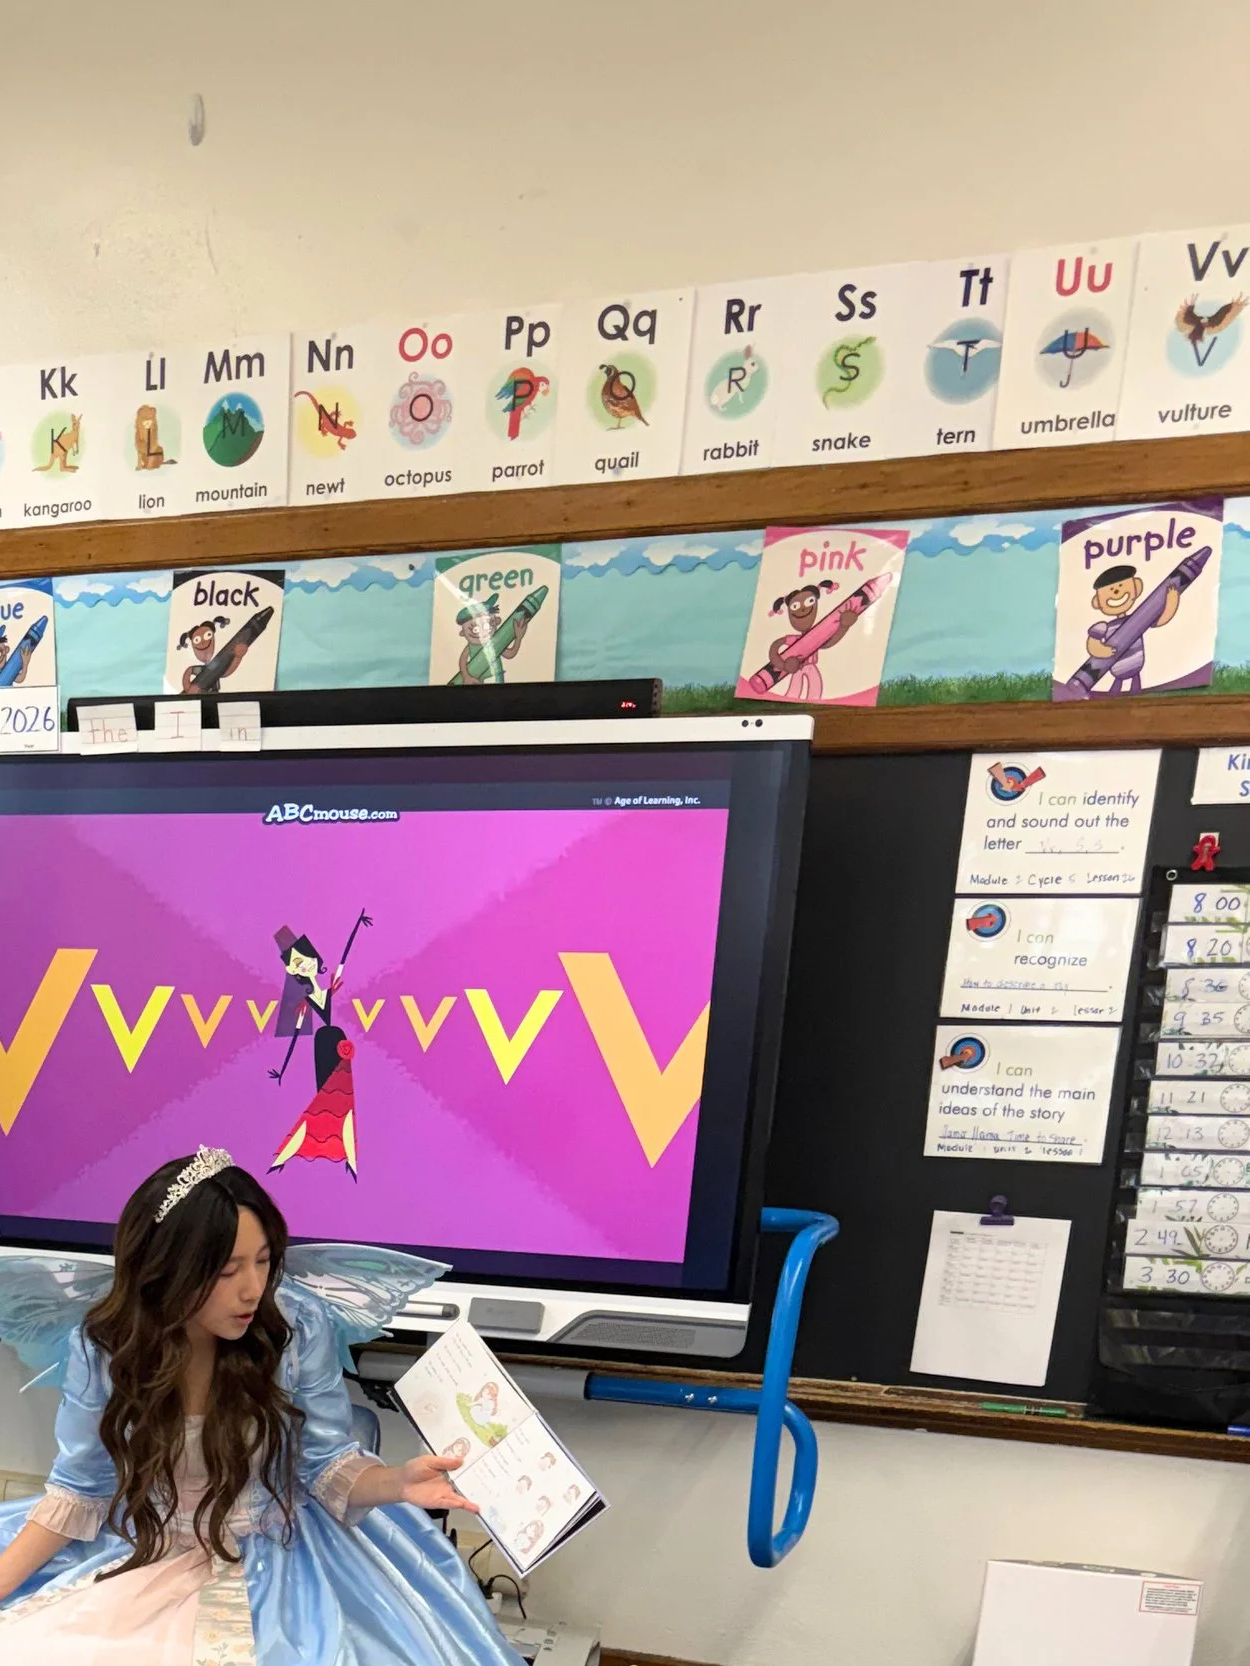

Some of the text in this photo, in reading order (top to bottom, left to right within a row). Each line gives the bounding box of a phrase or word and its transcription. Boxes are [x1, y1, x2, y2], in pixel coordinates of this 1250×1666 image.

[1187, 241, 1250, 282] Vv
[958, 267, 993, 307] Tt
[1055, 256, 1113, 296] Uu
[835, 284, 877, 321] Ss
[598, 304, 657, 345] Qq
[724, 299, 761, 334] Rr
[399, 327, 453, 362] Oo
[505, 316, 550, 357] Pp
[203, 349, 265, 384] Mm
[308, 339, 354, 373] Nn
[40, 366, 78, 400] Kk
[145, 358, 165, 391] Ll
[1020, 410, 1116, 435] umbrella
[1158, 401, 1232, 425] vulture
[812, 432, 871, 452] snake
[936, 427, 976, 446] tern
[703, 439, 759, 462] rabbit
[492, 459, 545, 481] parrot
[594, 452, 639, 474] quail
[305, 477, 345, 496] newt
[384, 469, 452, 488] octopus
[138, 494, 165, 509] lion
[195, 482, 268, 503] mountain
[24, 498, 92, 519] kangaroo
[1084, 518, 1198, 570] purple
[799, 541, 866, 577] pink
[459, 566, 534, 599] green
[194, 581, 260, 609] black
[89, 716, 129, 744] the
[170, 711, 186, 739] I
[228, 723, 249, 742] in
[615, 796, 700, 807] Age Learning, Inc.
[1049, 790, 1140, 809] can identify
[264, 803, 398, 823] ABCmouse.com
[987, 813, 1128, 828] and sound out the
[984, 837, 1022, 850] letter
[1027, 933, 1053, 943] can
[1014, 954, 1087, 968] recognize
[91, 985, 175, 1073] V
[181, 995, 233, 1048] V
[247, 1001, 278, 1034] V
[353, 999, 385, 1032] V
[400, 996, 457, 1052] V
[464, 989, 564, 1085] V
[558, 952, 711, 1168] V
[1006, 1065, 1032, 1077] can
[942, 1083, 1095, 1101] understand the main
[939, 1104, 1064, 1122] ideas of the story
[1140, 1266, 1190, 1284] 3 30
